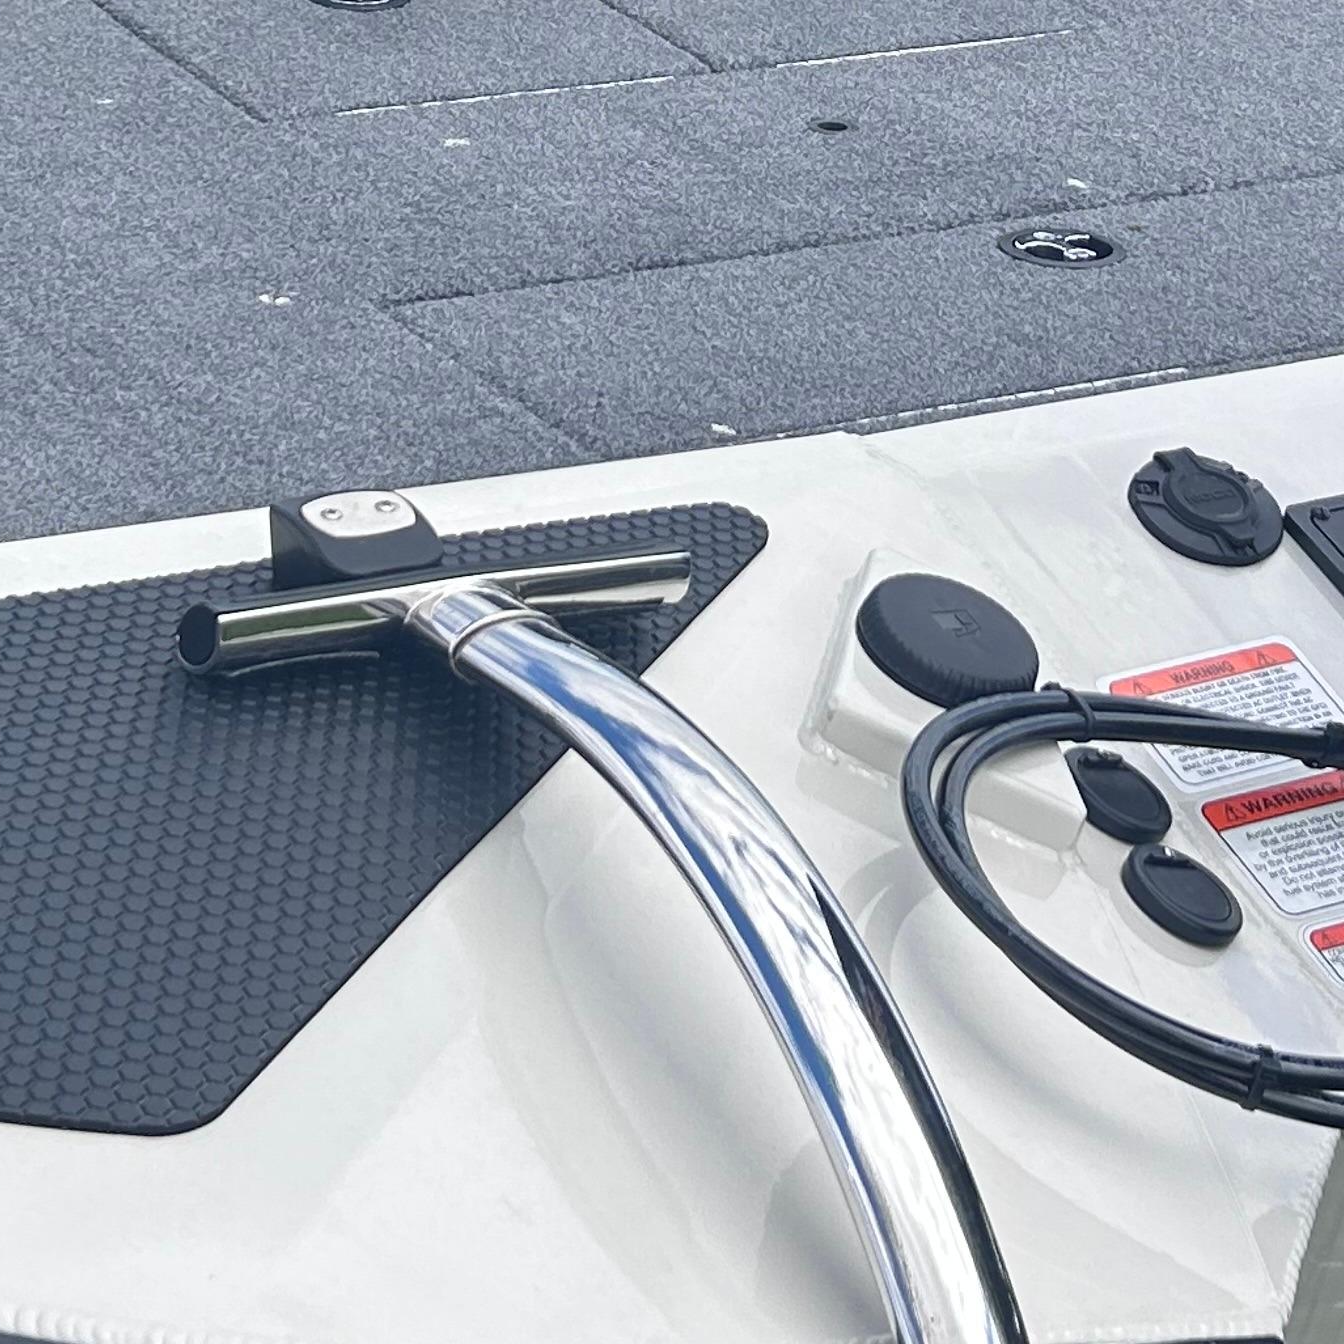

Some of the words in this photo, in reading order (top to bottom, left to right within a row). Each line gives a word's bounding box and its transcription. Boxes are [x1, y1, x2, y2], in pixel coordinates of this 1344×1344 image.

[1170, 660, 1235, 684] WARNING
[1243, 784, 1339, 814] WARNING
[1246, 826, 1273, 841] Avoid
[1274, 819, 1308, 834] serious
[1307, 812, 1335, 826] injury
[1261, 836, 1280, 848] that
[1282, 829, 1308, 842] could
[1271, 839, 1316, 857] explosion
